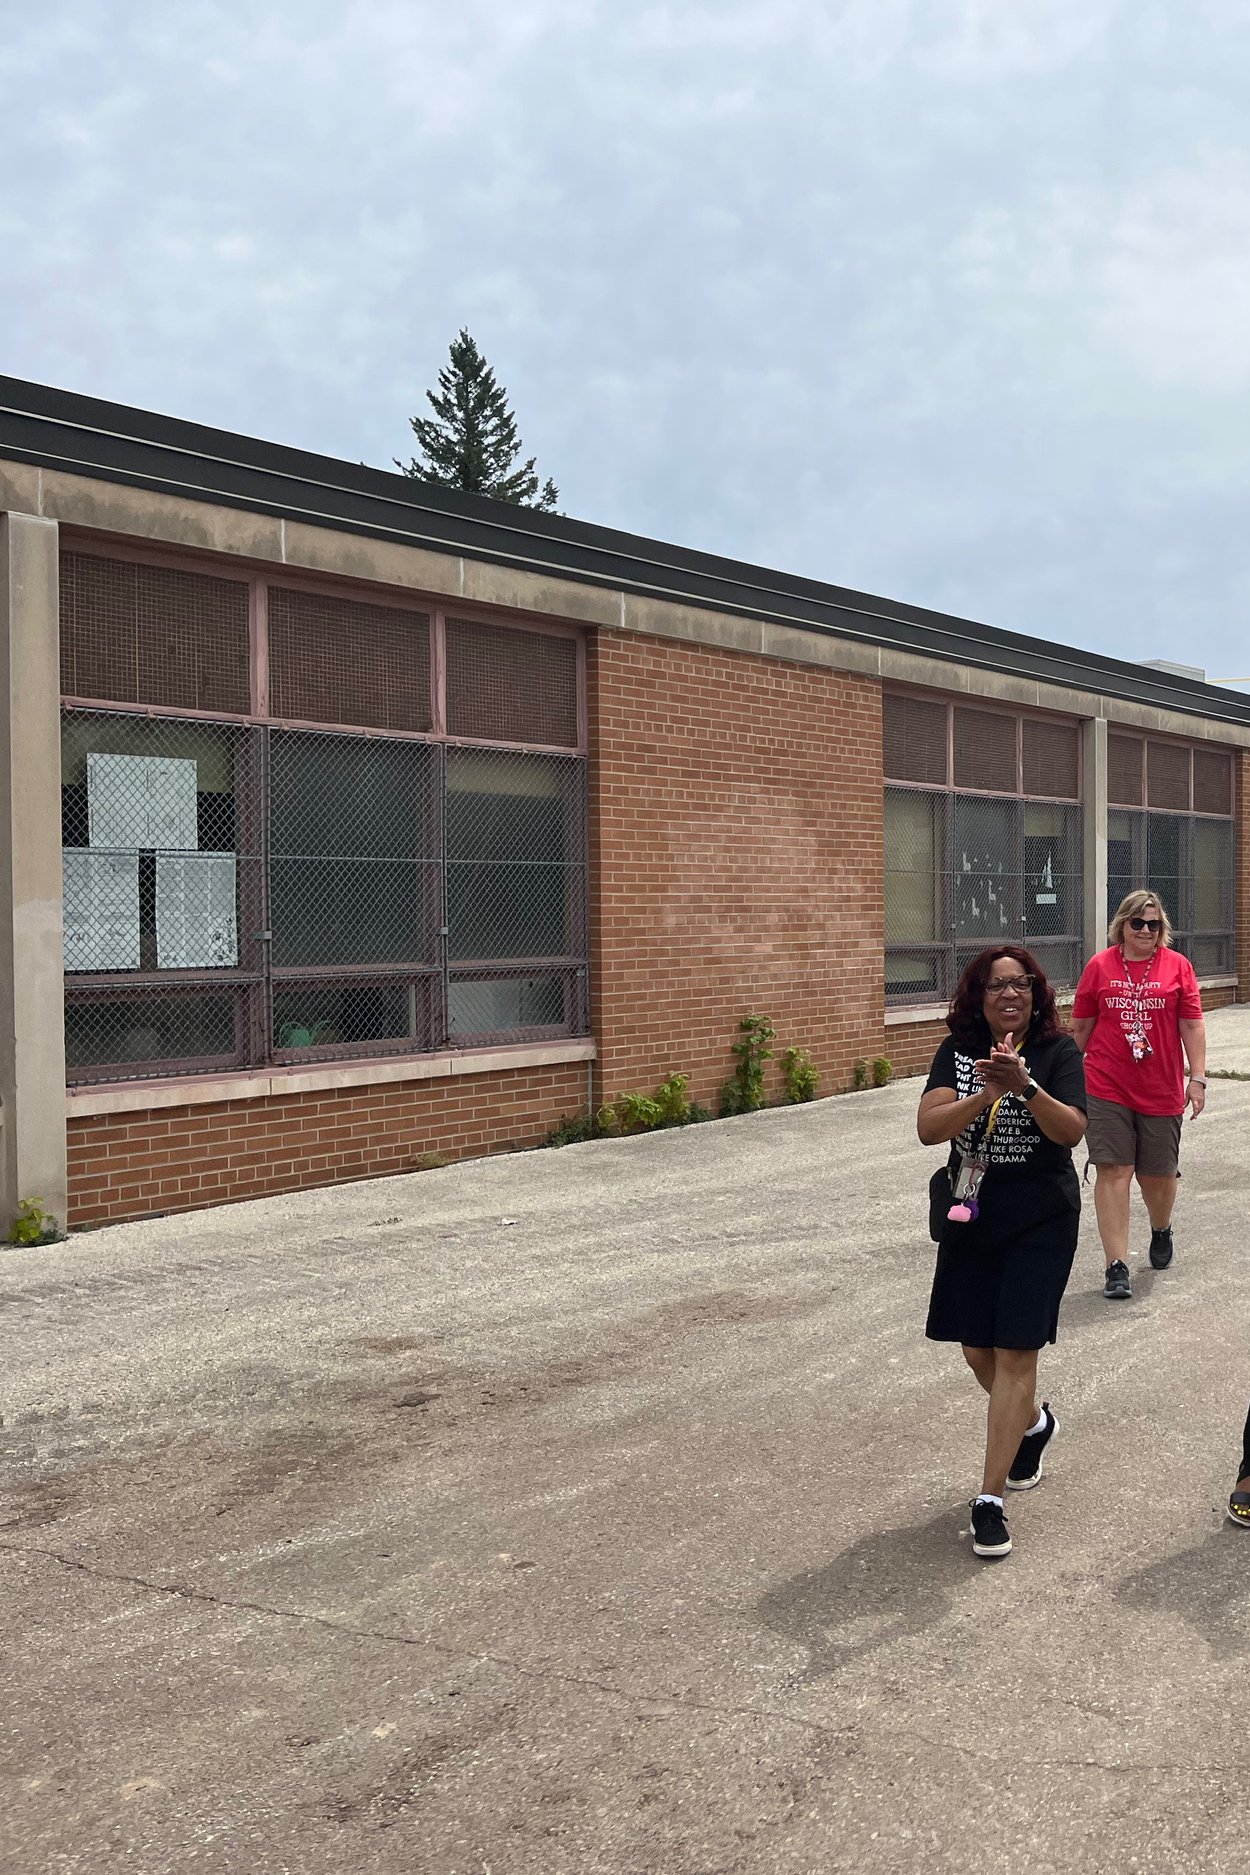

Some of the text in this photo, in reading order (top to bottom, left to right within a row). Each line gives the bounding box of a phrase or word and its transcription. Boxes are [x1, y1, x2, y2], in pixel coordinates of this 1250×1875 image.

[993, 1135, 1041, 1144] THURGOOD
[990, 1145, 1007, 1153] LIKE
[1009, 1145, 1034, 1153] ROSA
[991, 1155, 1027, 1163] OBAMA
